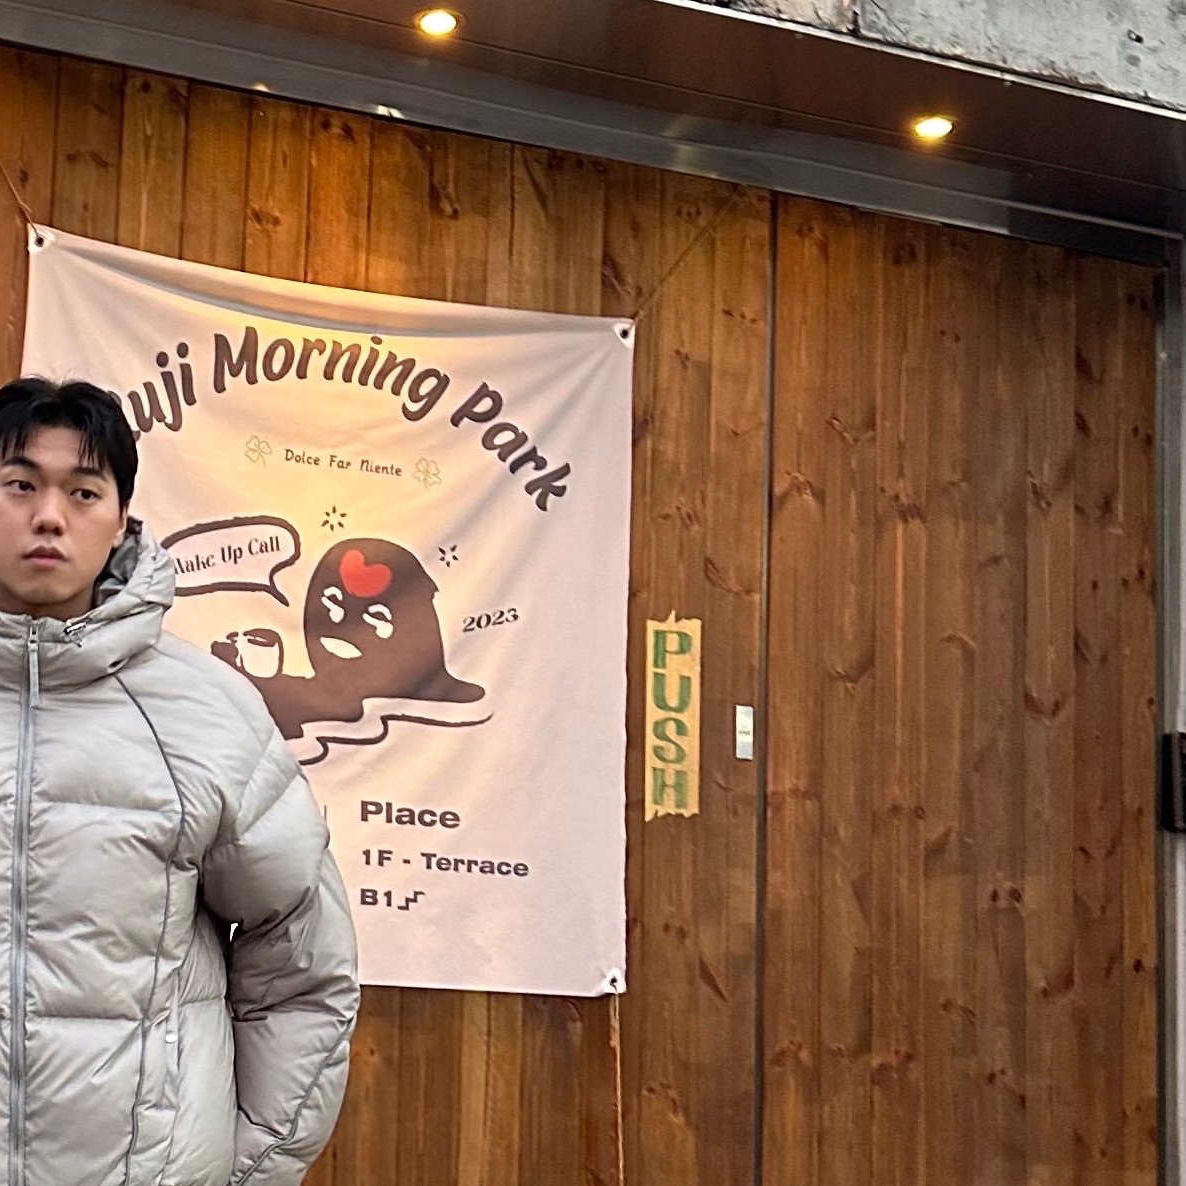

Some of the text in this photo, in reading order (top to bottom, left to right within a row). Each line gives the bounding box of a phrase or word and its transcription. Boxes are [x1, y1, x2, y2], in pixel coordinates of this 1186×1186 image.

[107, 326, 571, 512] uji Morning Park
[284, 448, 402, 477] Dolce Far Niente
[220, 544, 244, 564] Up
[247, 535, 282, 557] Call
[462, 607, 520, 633] 2023
[652, 629, 693, 810] PUSH
[360, 800, 462, 829] Place
[362, 849, 394, 867] 1F
[420, 852, 530, 877] Terrace
[360, 888, 393, 908] B1
